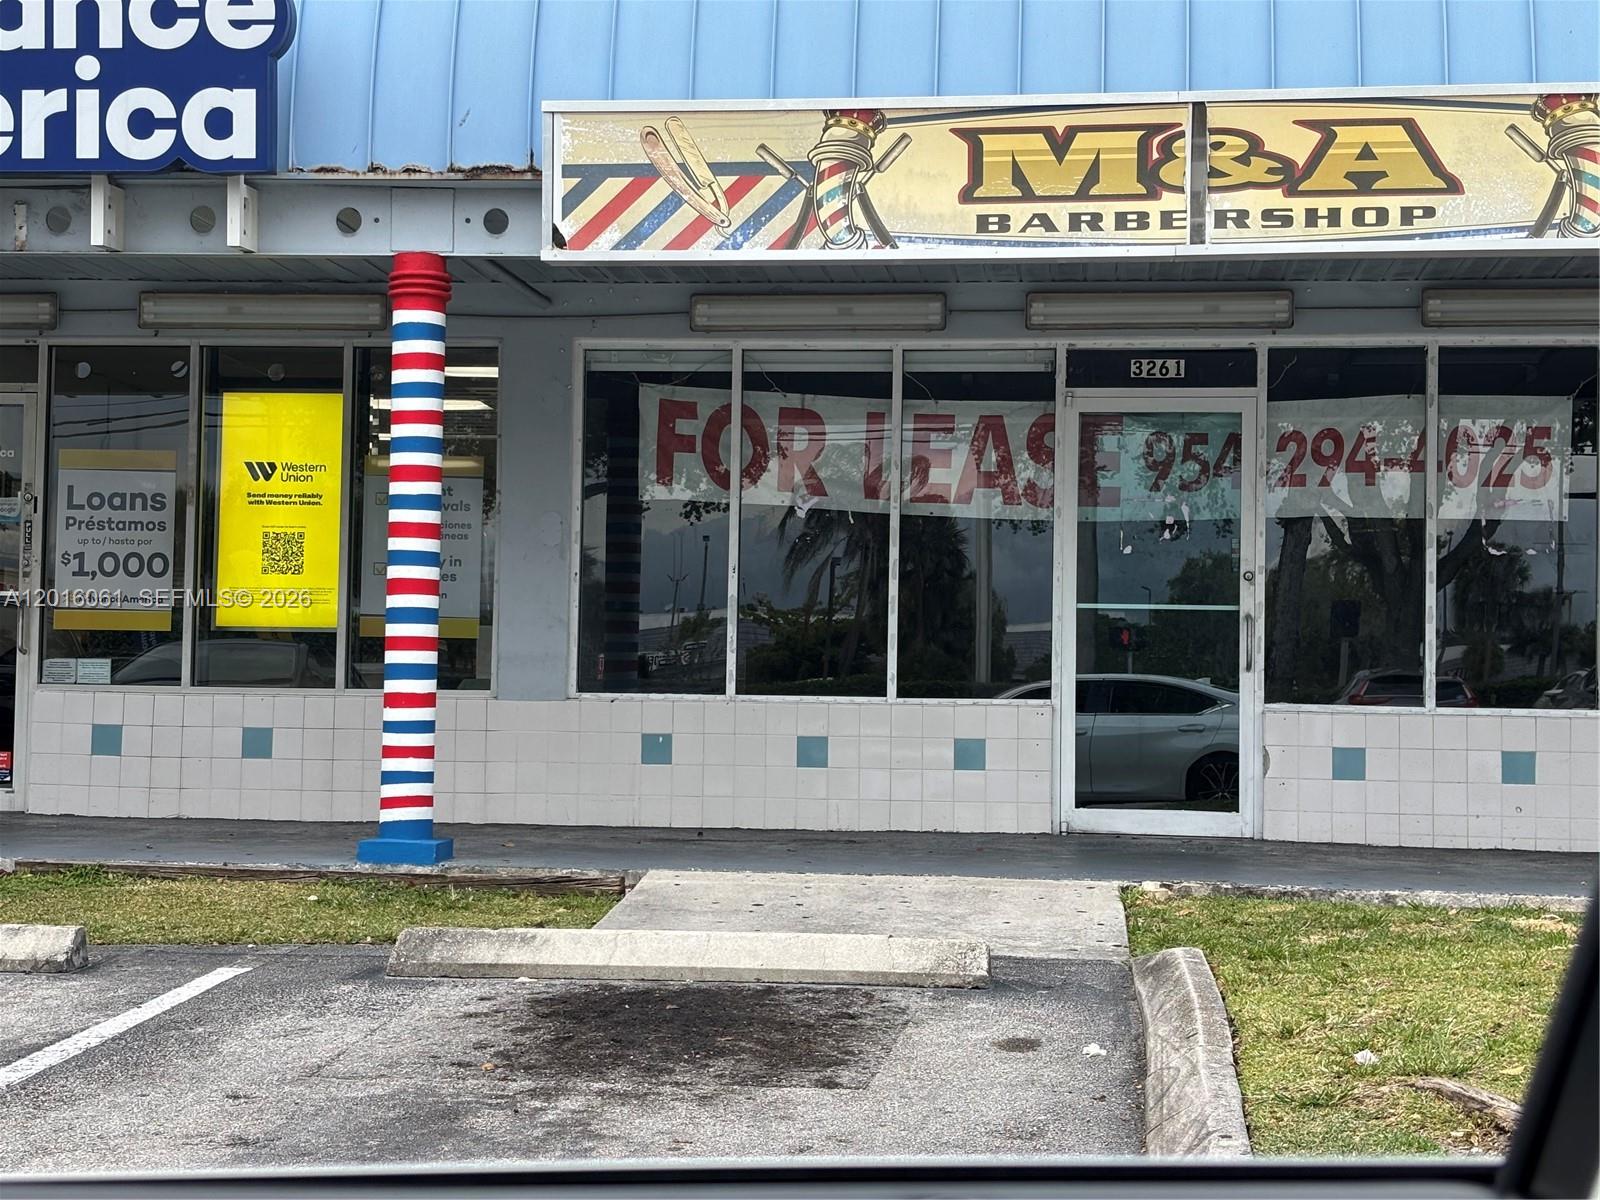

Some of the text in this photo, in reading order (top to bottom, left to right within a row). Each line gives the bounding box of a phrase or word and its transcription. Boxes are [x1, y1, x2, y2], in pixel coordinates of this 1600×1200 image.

[0, 55, 256, 160] rica
[950, 117, 1465, 204] M&A
[975, 205, 1437, 234] BARBERSHOP
[1132, 360, 1182, 377] 3261
[281, 462, 327, 472] Western
[656, 398, 829, 497] FOR
[864, 411, 1123, 509] LEASE
[1143, 430, 1242, 492] 954
[281, 472, 314, 482] Union
[67, 485, 167, 512] Loans
[65, 516, 167, 532] Préstamos
[77, 538, 89, 547] up
[91, 537, 101, 545] to
[108, 537, 135, 546] hasta
[137, 539, 153, 547] por
[60, 550, 170, 580] $1,000
